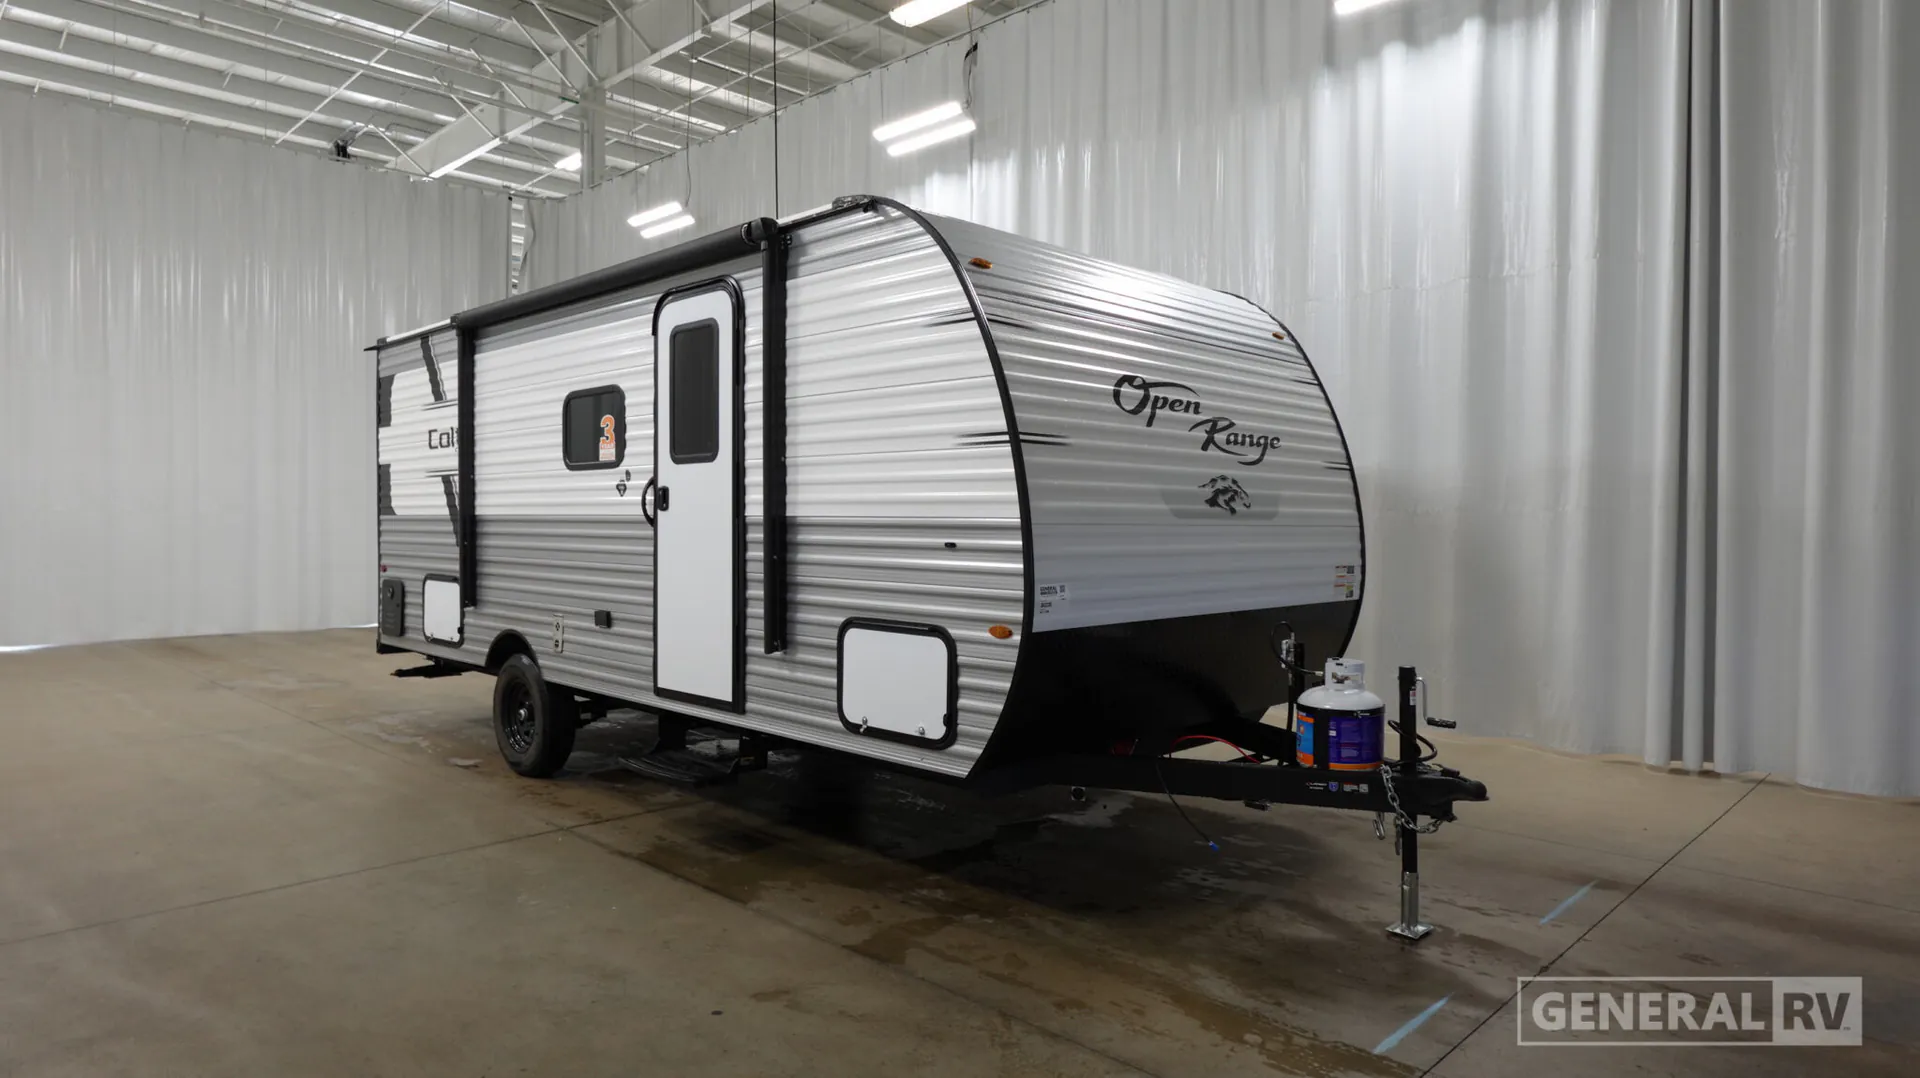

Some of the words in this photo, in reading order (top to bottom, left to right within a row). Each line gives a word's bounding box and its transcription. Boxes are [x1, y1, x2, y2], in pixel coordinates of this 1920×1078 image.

[1113, 375, 1202, 427] Open
[600, 415, 615, 444] 3
[1188, 416, 1281, 466] Range
